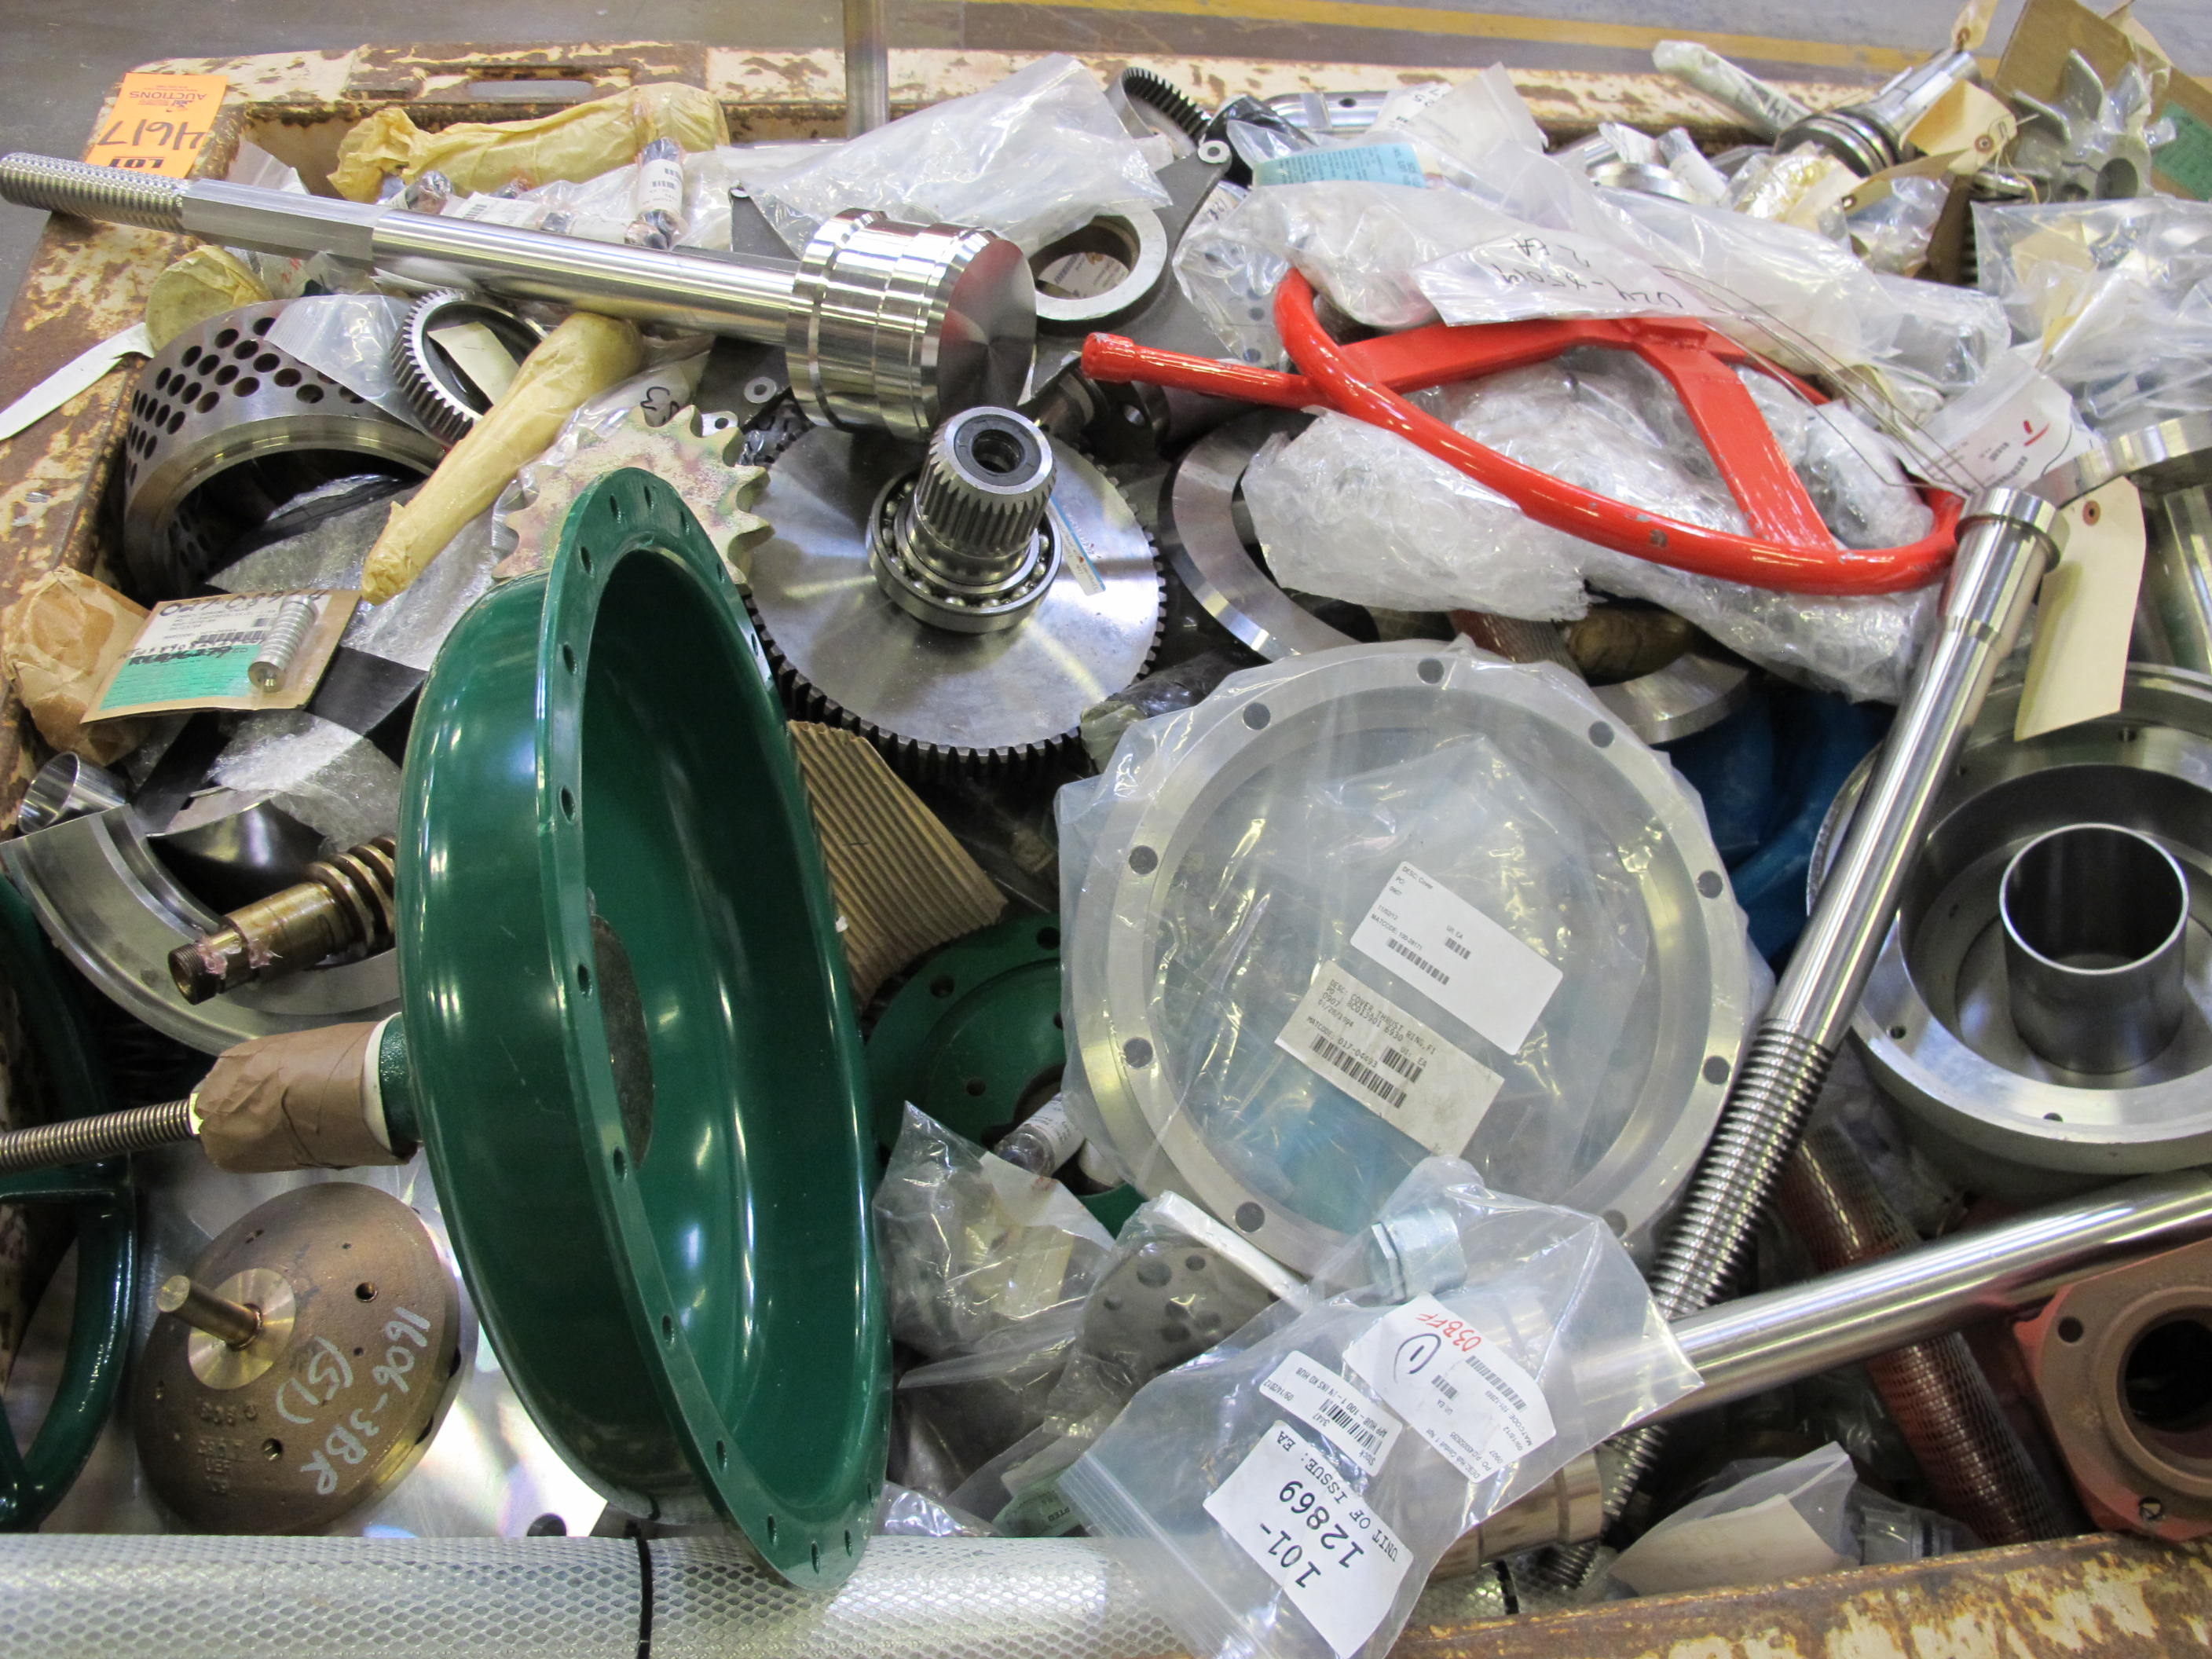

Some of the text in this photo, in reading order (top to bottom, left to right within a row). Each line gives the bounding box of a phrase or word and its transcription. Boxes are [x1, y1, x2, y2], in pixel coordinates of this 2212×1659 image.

[129, 91, 207, 100] AUCTIONS
[96, 119, 207, 150] 4617
[108, 158, 163, 168] LOT
[1321, 991, 1340, 1008] 0907
[1416, 1057, 1428, 1068] EA
[1295, 1366, 1310, 1379] HUB
[1264, 1379, 1294, 1401] 09/14/2012
[300, 1309, 431, 1494] 1606-3BR
[1436, 1398, 1445, 1408] EA
[1362, 1417, 1377, 1430] HUB
[1357, 1448, 1376, 1466] Stock
[1489, 1448, 1503, 1463] 0907
[1273, 1429, 1398, 1561] UNIT OF ISSUE: EA
[1276, 1482, 1365, 1563] 12869
[1259, 1522, 1321, 1588] 101-
